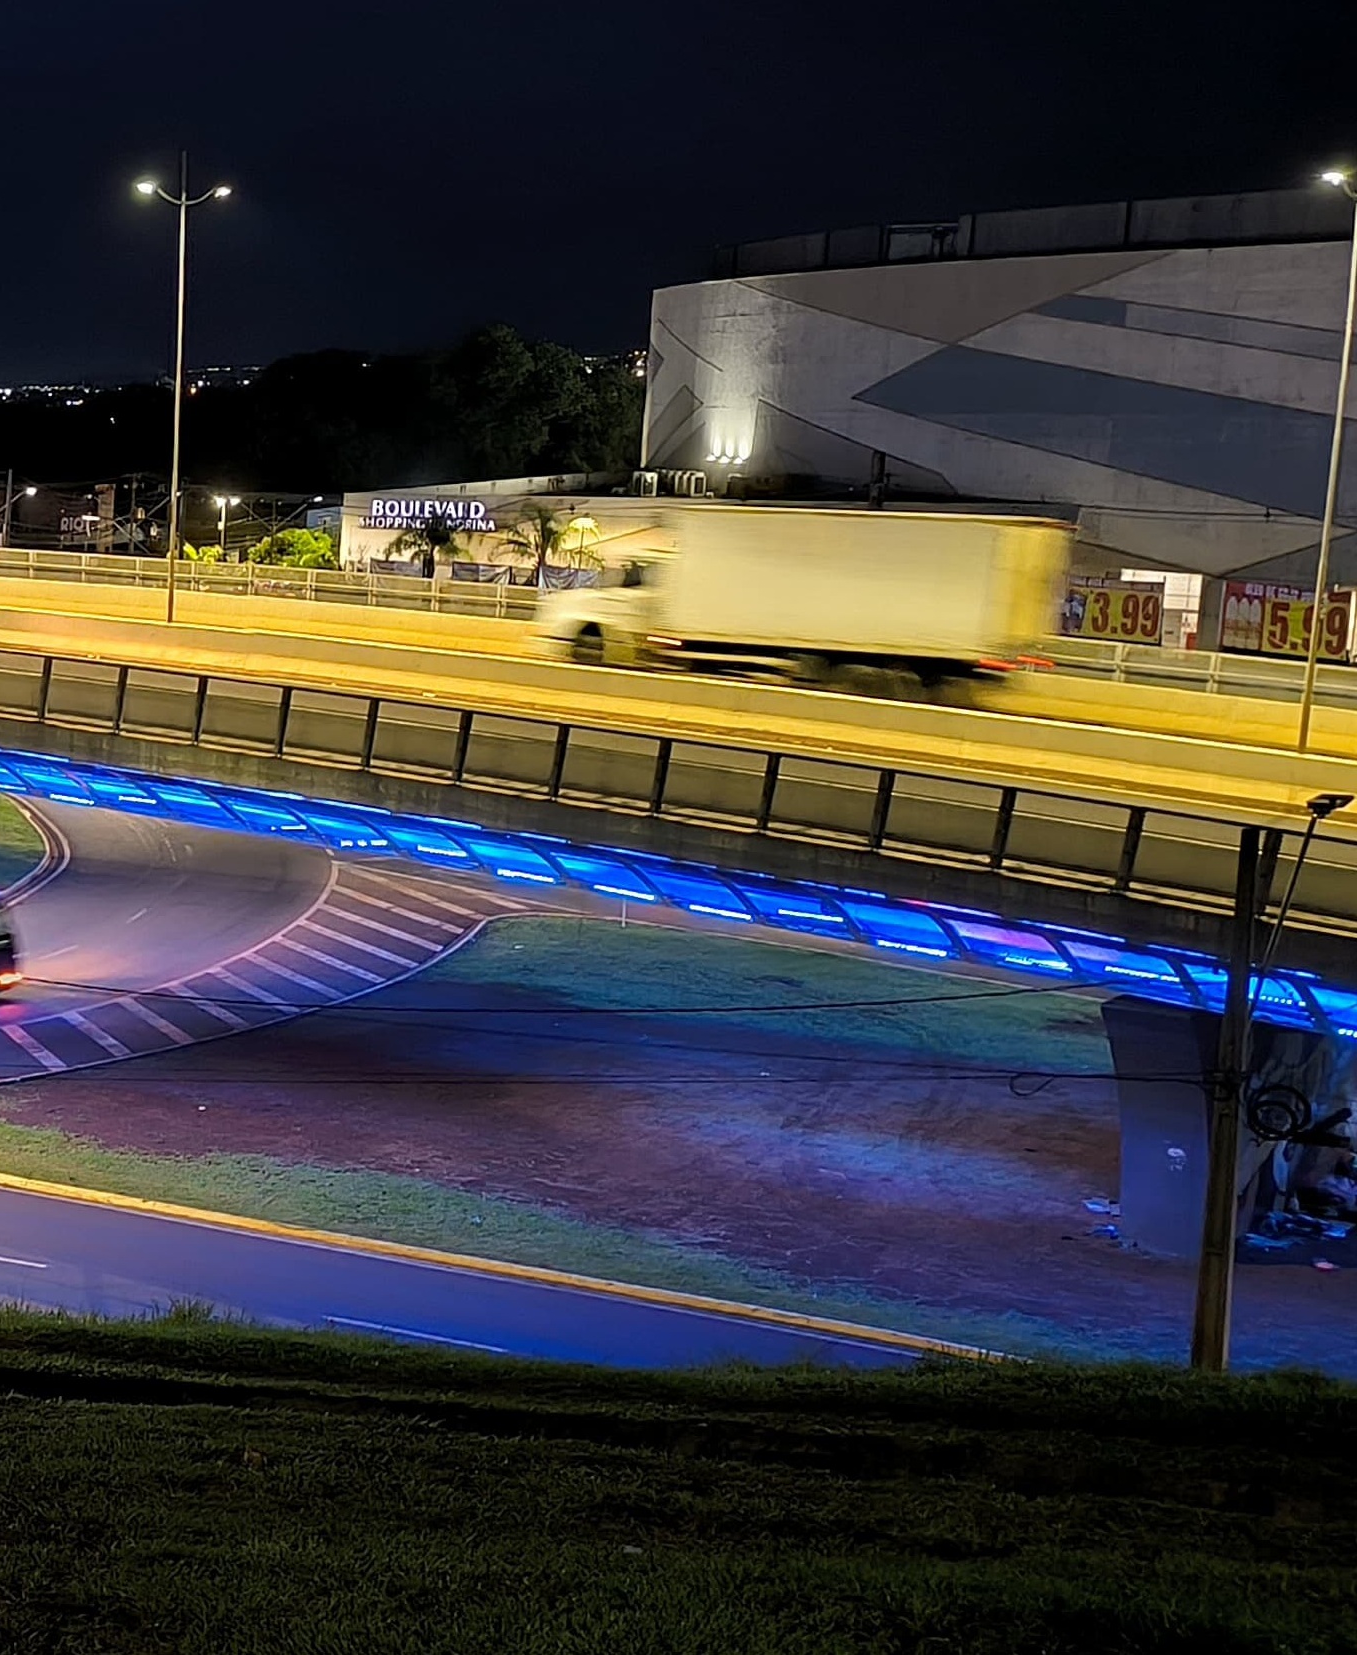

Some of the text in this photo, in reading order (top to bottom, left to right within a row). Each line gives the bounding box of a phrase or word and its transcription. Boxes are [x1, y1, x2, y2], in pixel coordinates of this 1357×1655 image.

[358, 516, 427, 529] SHOPPING
[1091, 592, 1160, 637] 3.99
[1267, 601, 1347, 656] 5.99
